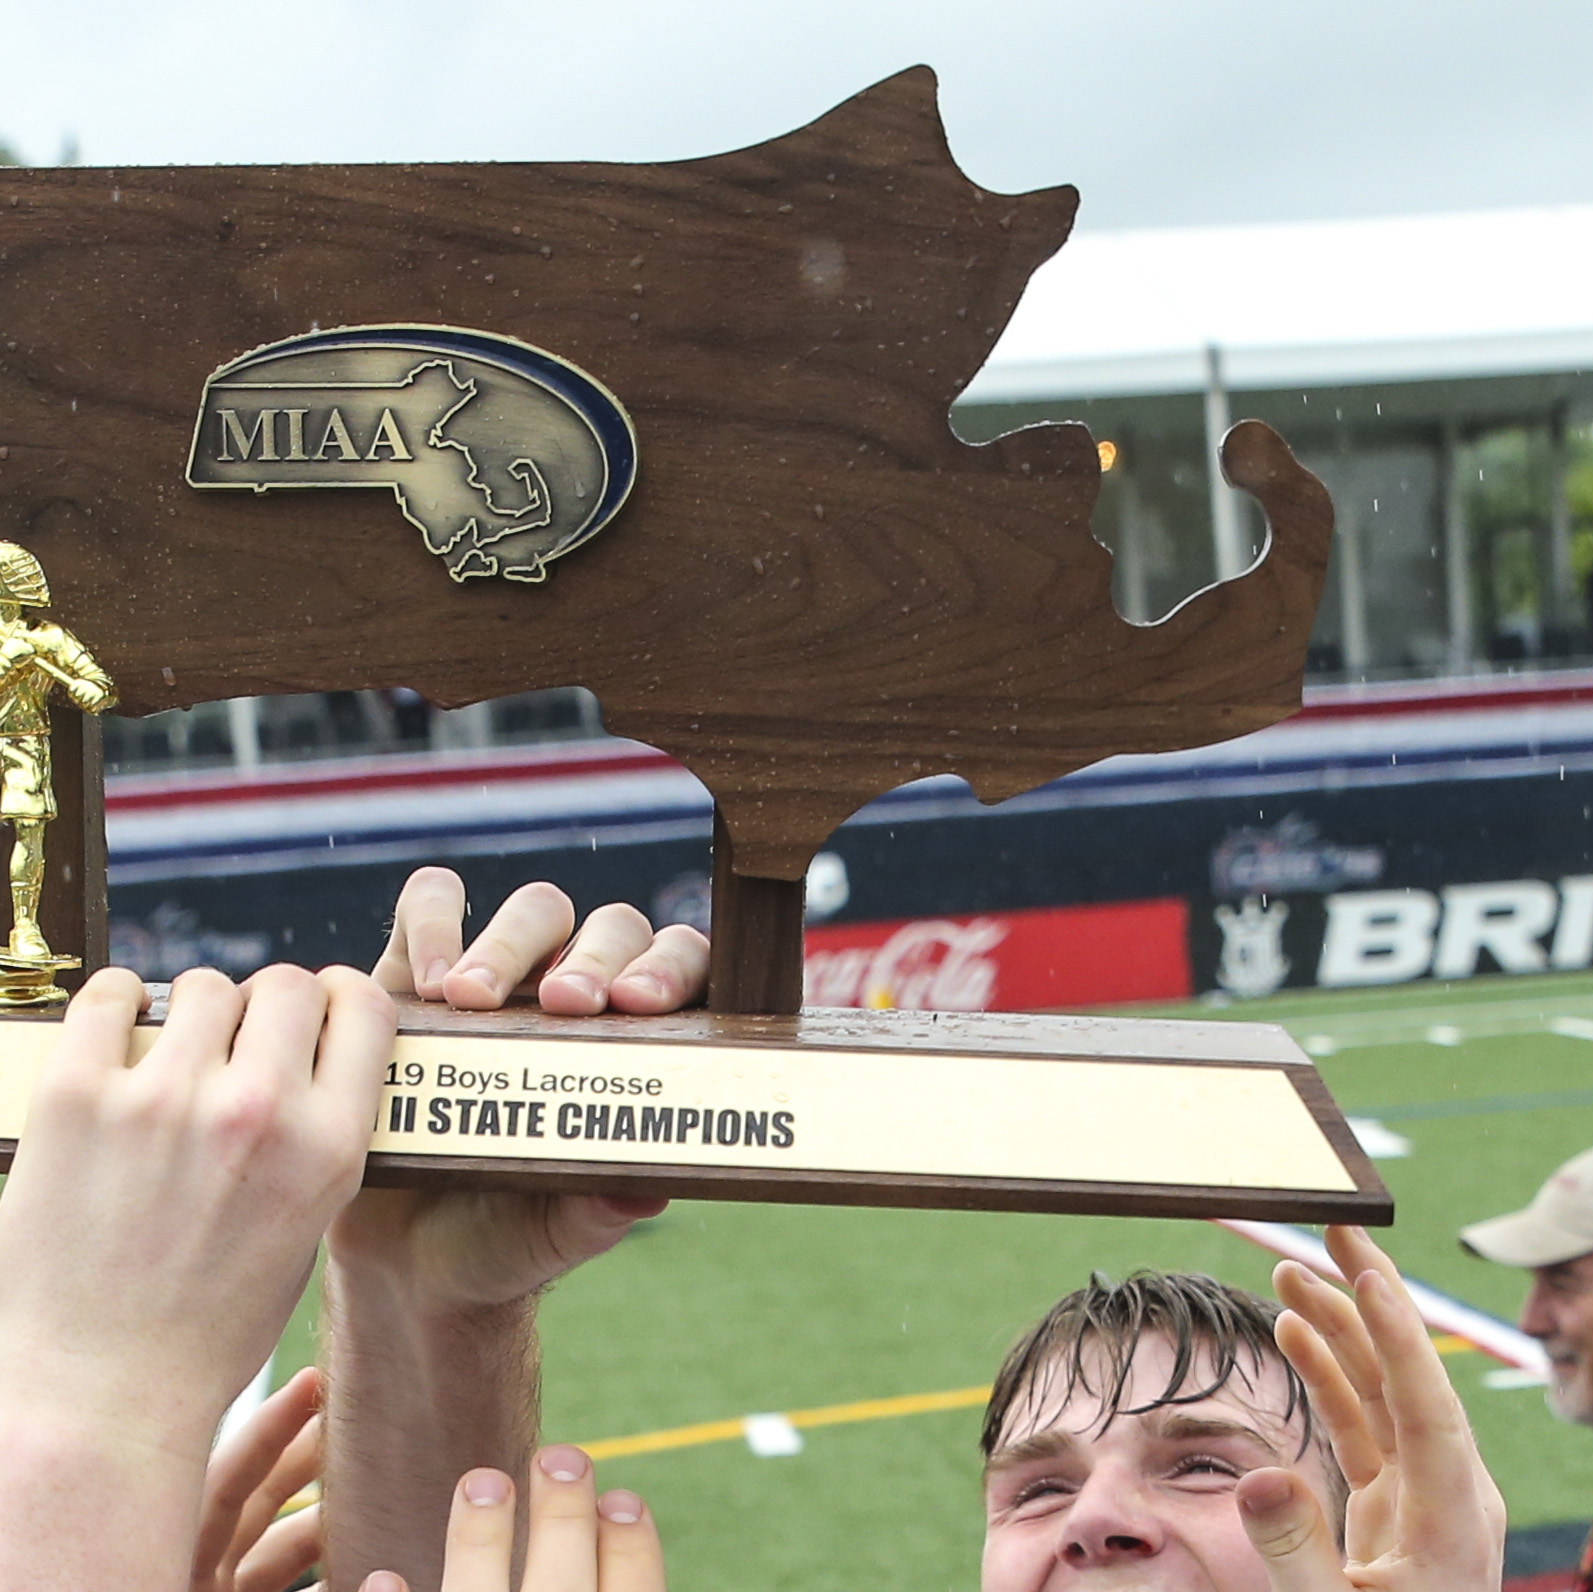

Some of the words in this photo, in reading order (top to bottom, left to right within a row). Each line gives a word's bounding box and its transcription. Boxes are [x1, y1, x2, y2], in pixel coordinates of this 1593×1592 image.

[216, 407, 413, 462] MIAA
[383, 1061, 425, 1087] 19
[436, 1063, 509, 1096] Boys
[522, 1067, 663, 1097] Lacrosse
[428, 1096, 545, 1138] STATE
[557, 1102, 795, 1149] CHAMPIONS
